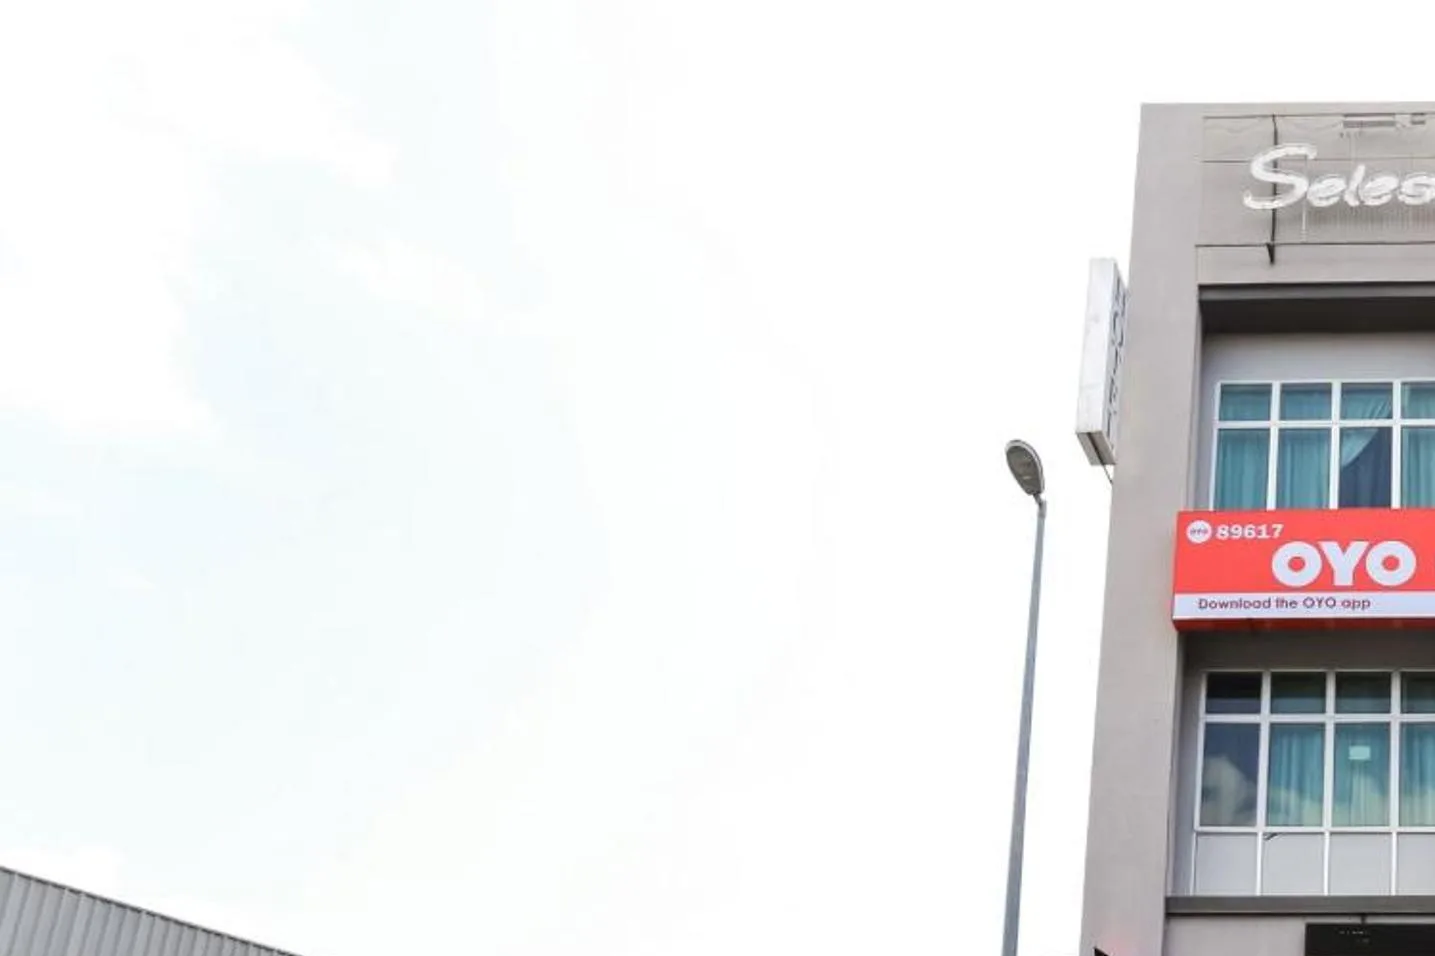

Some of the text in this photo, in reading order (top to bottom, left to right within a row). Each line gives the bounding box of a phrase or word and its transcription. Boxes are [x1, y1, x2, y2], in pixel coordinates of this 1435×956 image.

[1215, 523, 1284, 539] 89617
[1271, 540, 1417, 588] OYO
[1198, 596, 1371, 611] Download the OYO app
